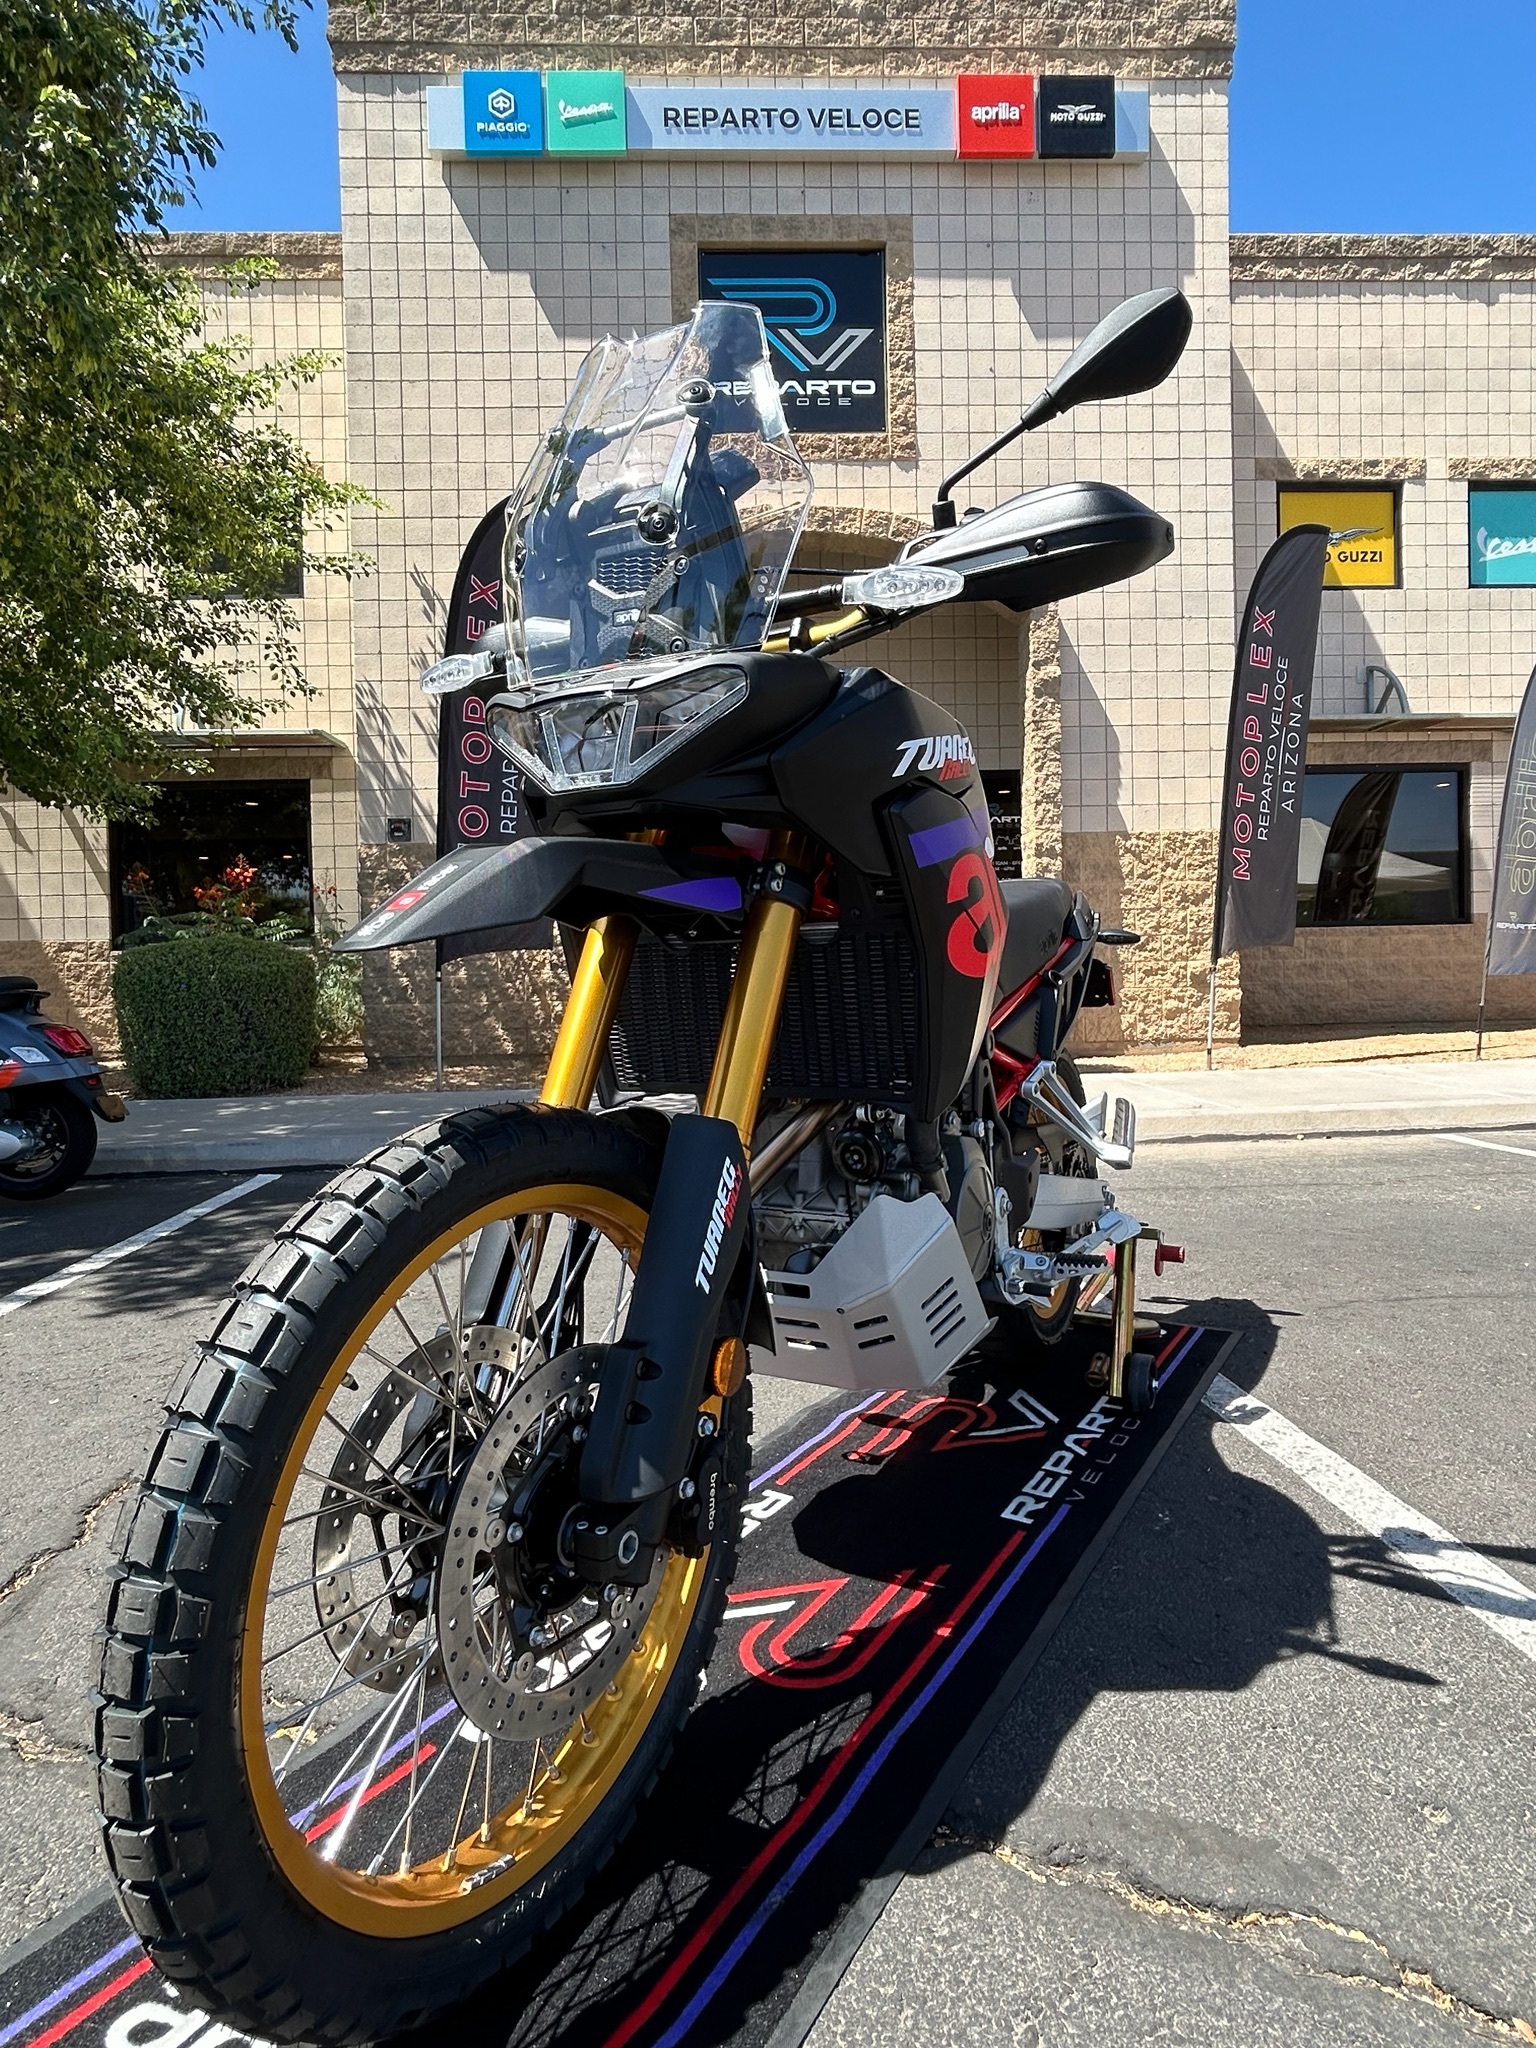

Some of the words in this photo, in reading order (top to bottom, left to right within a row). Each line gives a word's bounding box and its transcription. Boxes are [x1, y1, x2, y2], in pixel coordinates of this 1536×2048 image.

[476, 122, 528, 132] PIAGGIO
[663, 107, 799, 128] REPARTO
[807, 108, 920, 129] VELOCE
[971, 103, 1020, 122] aprilia
[1050, 112, 1074, 122] MOTO
[1077, 112, 1104, 122] GUZZI
[713, 380, 876, 396] REARTO
[1337, 551, 1383, 562] GUZZI
[456, 574, 500, 849] OTOPEX
[1233, 606, 1276, 880] MOTOPLEX
[1257, 744, 1278, 841] REPARTO
[1269, 656, 1289, 740] VELOCE
[1281, 693, 1304, 814] ARIZONA
[695, 1156, 736, 1295] TUAREG
[1000, 1395, 1123, 1525] REPART
[1065, 1418, 1141, 1501] VELOC
[708, 1472, 718, 1531] brembo
